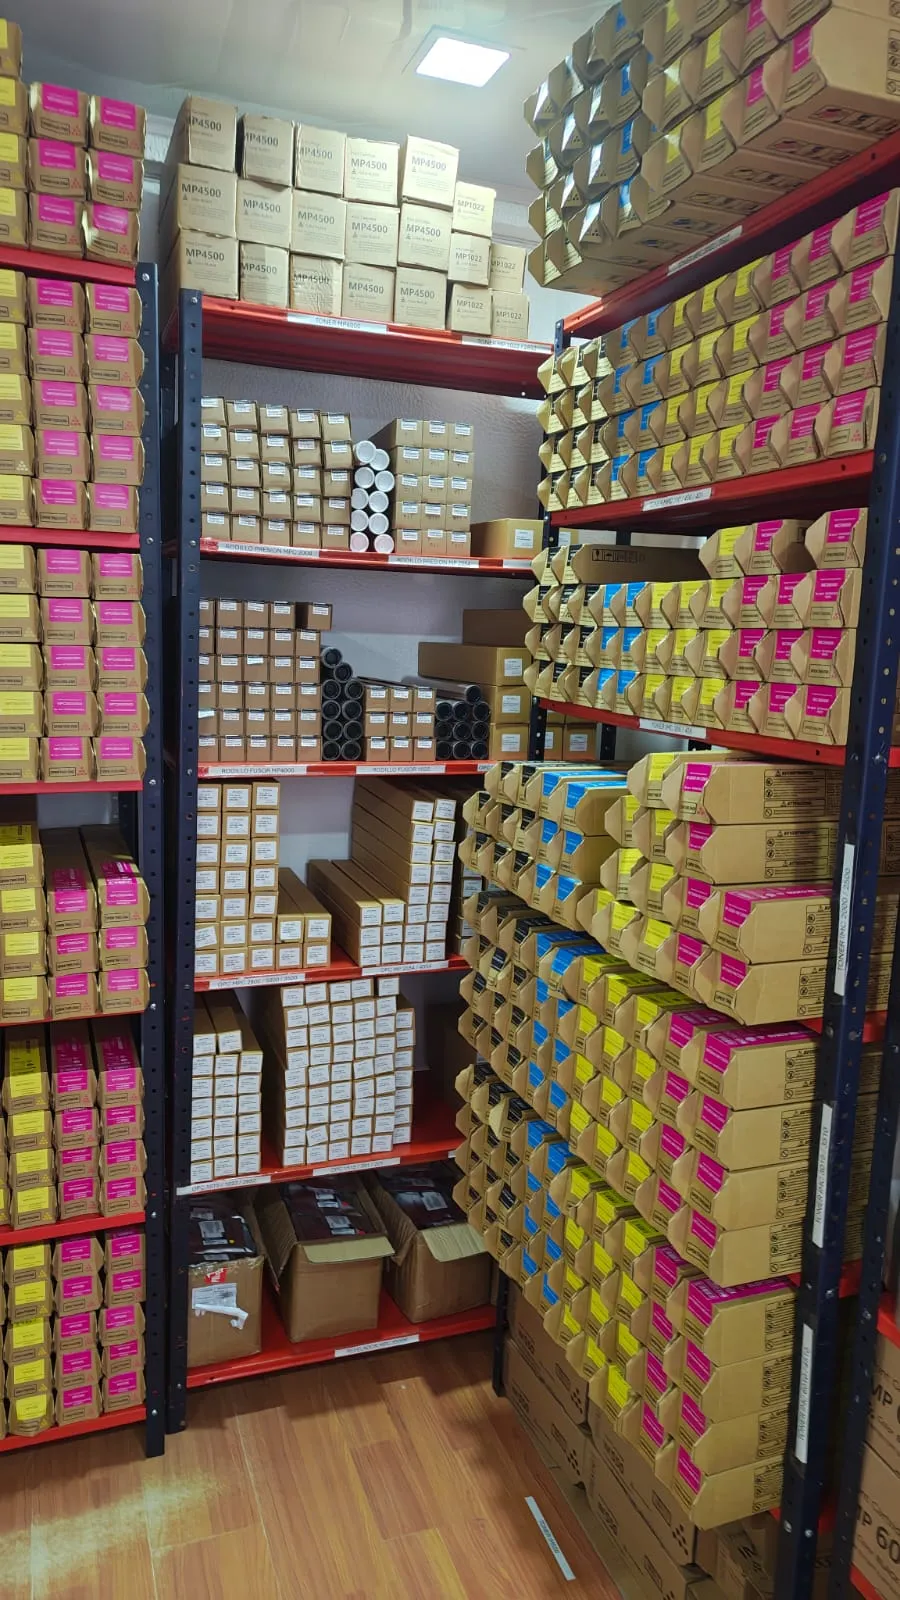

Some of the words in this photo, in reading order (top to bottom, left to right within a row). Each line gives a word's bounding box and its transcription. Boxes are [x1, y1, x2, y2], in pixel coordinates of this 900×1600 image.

[350, 158, 388, 171] MP4500
[411, 155, 447, 172] MP4500
[181, 183, 222, 198] MP4500
[243, 199, 281, 214] MP4500
[457, 199, 486, 212] MP1022
[298, 211, 335, 225] MP4500
[351, 221, 388, 234] MP4500
[406, 222, 441, 238] MP4500
[185, 247, 225, 262] MP4500
[455, 252, 482, 263] MP1022
[240, 262, 277, 274] MP4500
[348, 281, 384, 295] MP4500
[400, 287, 435, 299] MP4500
[456, 299, 484, 310] MP1022
[496, 310, 522, 320] MP1022
[836, 938, 847, 971] TONER
